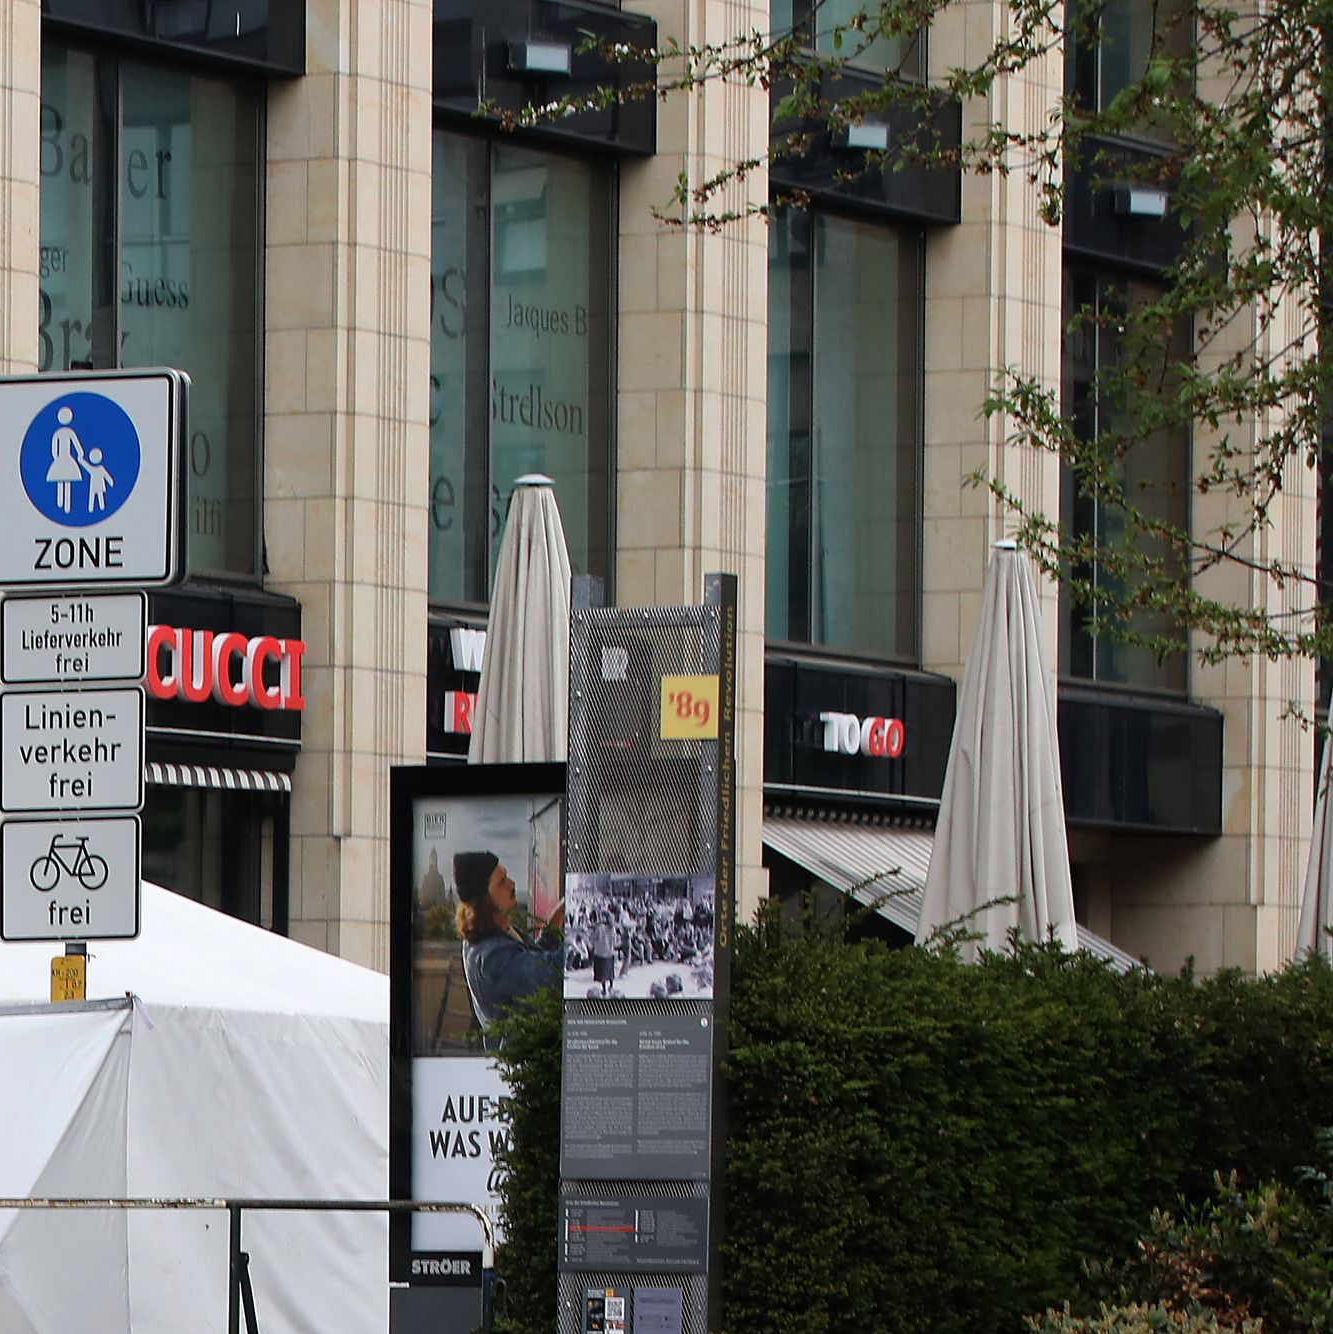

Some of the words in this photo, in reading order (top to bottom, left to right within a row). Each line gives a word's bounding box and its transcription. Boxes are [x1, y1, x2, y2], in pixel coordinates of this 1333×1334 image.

[506, 294, 569, 339] Jacques
[34, 537, 124, 569] ZONE
[22, 629, 122, 651] Lieferverkehr
[55, 654, 90, 674] frei
[722, 606, 734, 721] Revolution
[25, 704, 117, 730] Linien-
[819, 711, 860, 755] TO
[861, 716, 905, 758] GO
[19, 738, 122, 764] verkehr
[49, 773, 93, 798] frei
[719, 731, 731, 850] Friedlichen
[719, 857, 730, 894] der
[48, 900, 91, 925] frei
[429, 1131, 481, 1158] WAS
[411, 1258, 471, 1275] STRÖER
